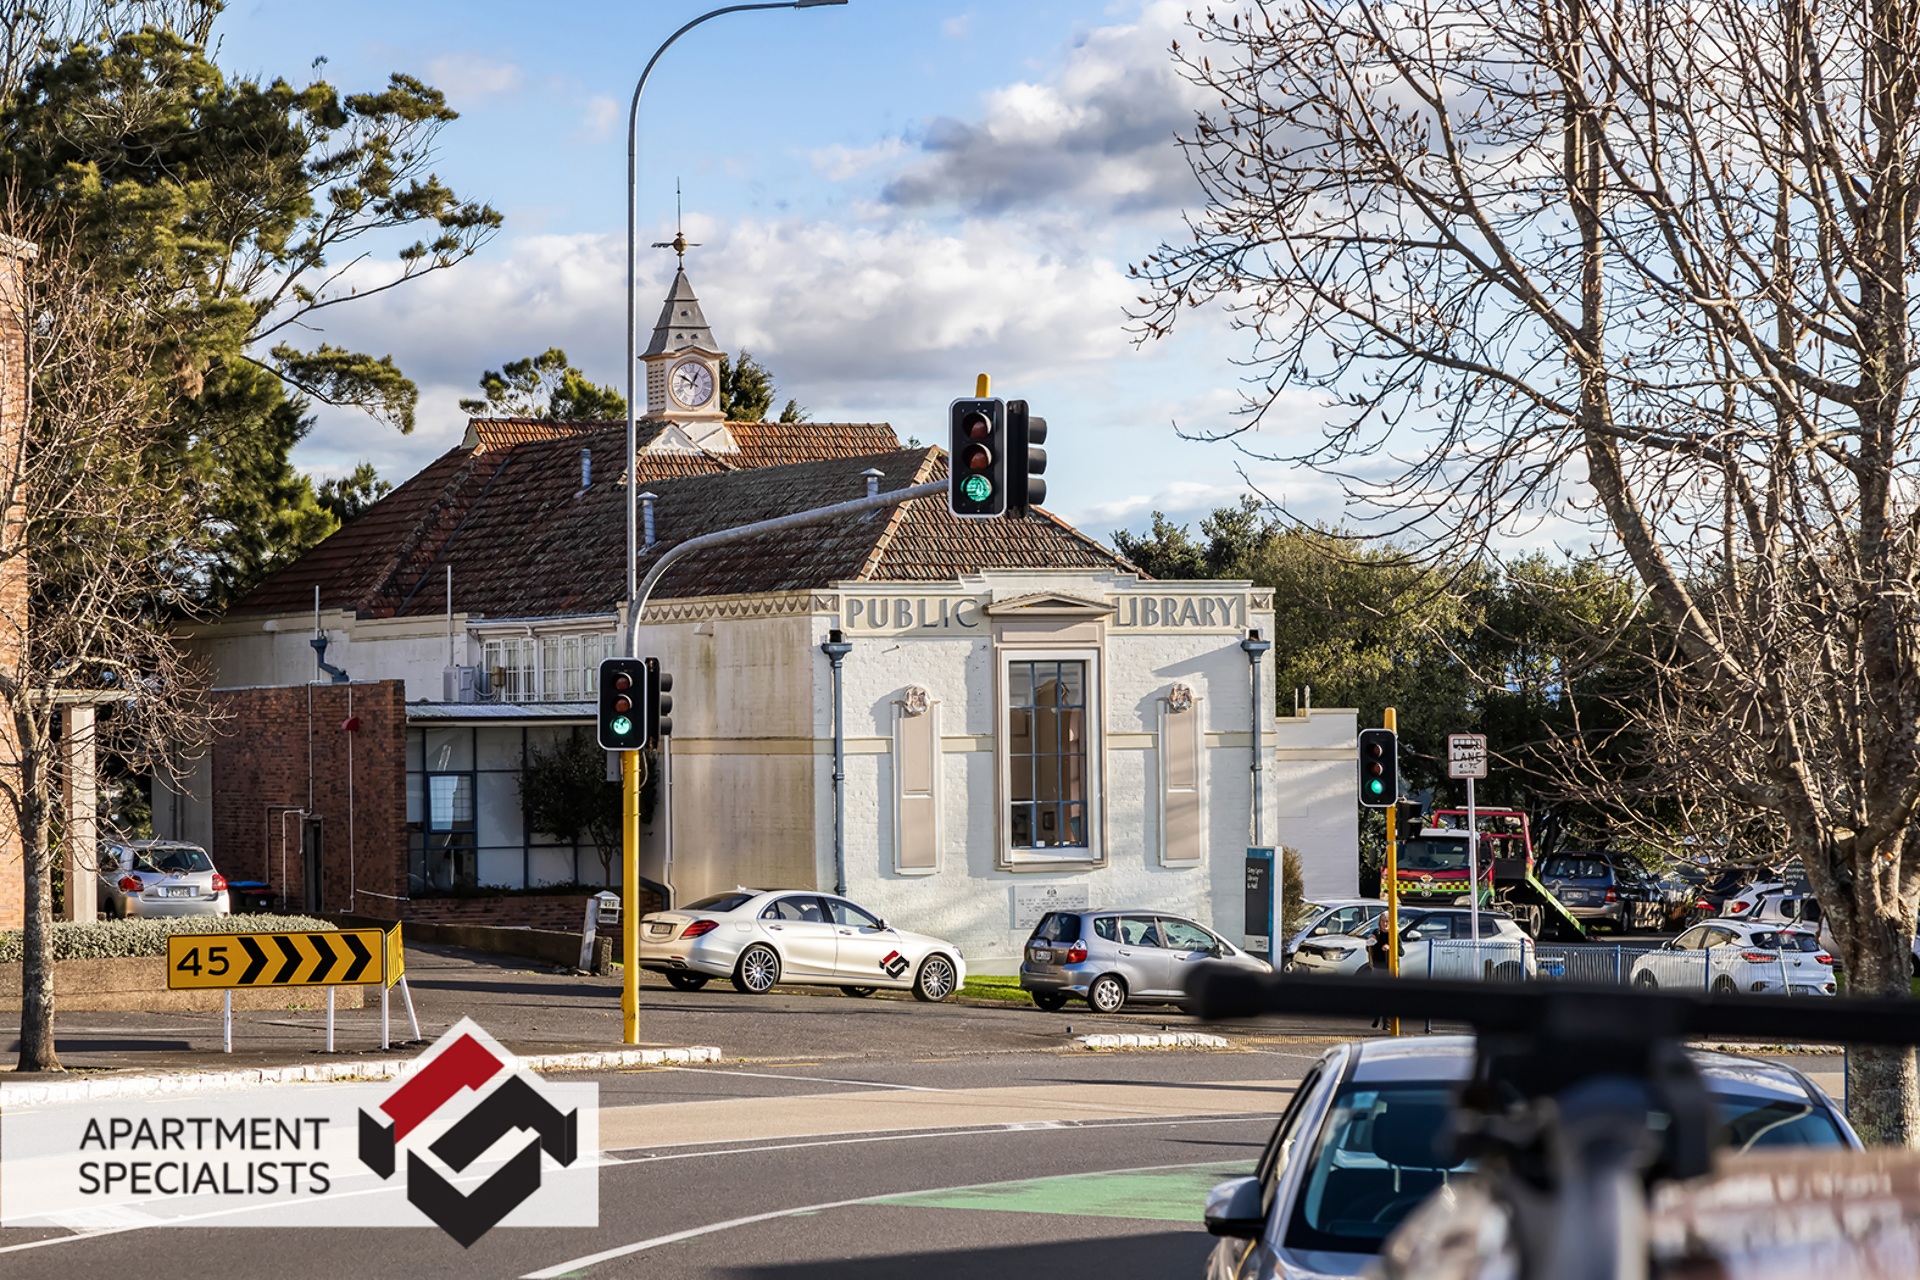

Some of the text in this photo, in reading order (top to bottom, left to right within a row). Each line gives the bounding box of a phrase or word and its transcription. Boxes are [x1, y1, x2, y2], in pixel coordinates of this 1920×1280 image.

[846, 597, 1237, 628] PUBLIC LIBRARY
[1453, 752, 1482, 762] LANE
[177, 946, 230, 976] 45
